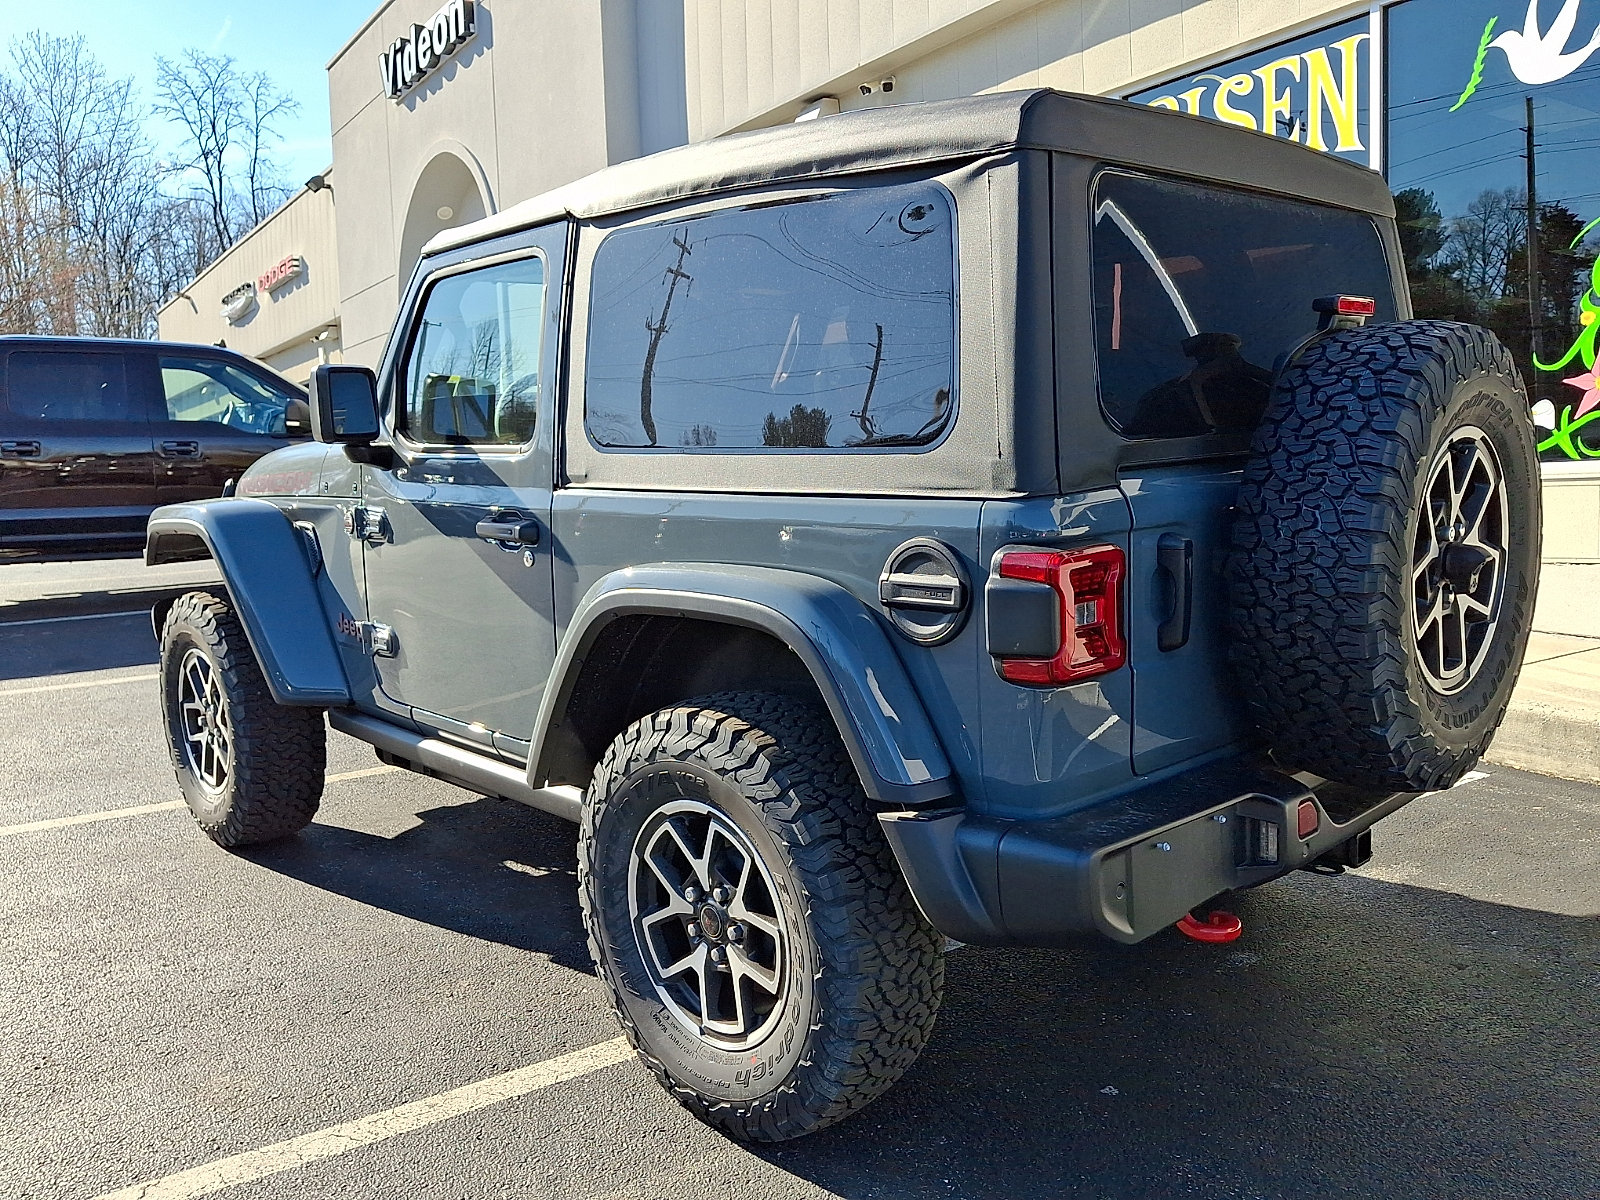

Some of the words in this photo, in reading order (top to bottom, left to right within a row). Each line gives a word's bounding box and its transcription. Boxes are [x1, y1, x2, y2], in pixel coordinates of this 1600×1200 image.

[378, 0, 471, 99] Videon
[1148, 33, 1371, 152] ISEN
[258, 255, 297, 292] DODGE
[925, 591, 948, 599] FUEL
[337, 612, 363, 643] Jeep
